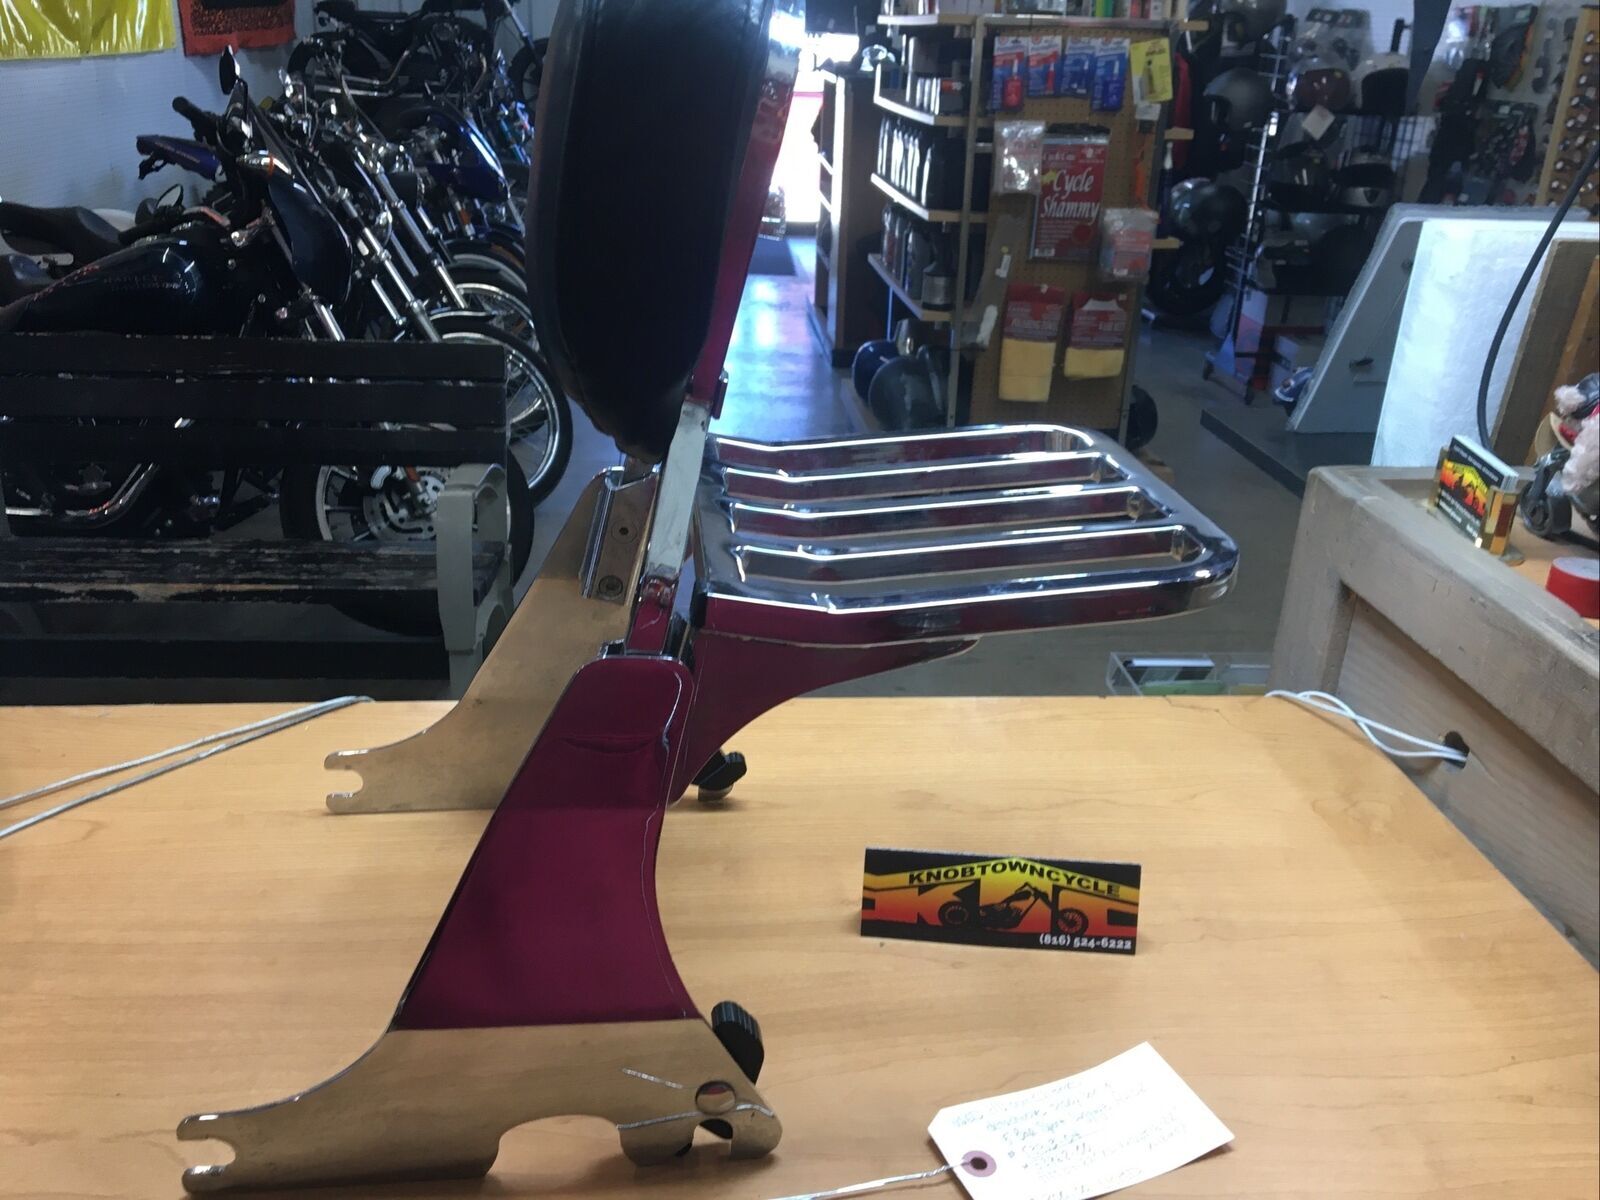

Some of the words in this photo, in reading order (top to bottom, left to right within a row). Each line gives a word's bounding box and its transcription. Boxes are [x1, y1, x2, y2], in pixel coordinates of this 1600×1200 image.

[1053, 166, 1094, 199] Cycle
[1040, 193, 1100, 226] Shammy
[908, 860, 1121, 897] KNOBTOWNCYCLE
[1039, 932, 1071, 947] (816)
[1073, 936, 1132, 950] 524-6222
